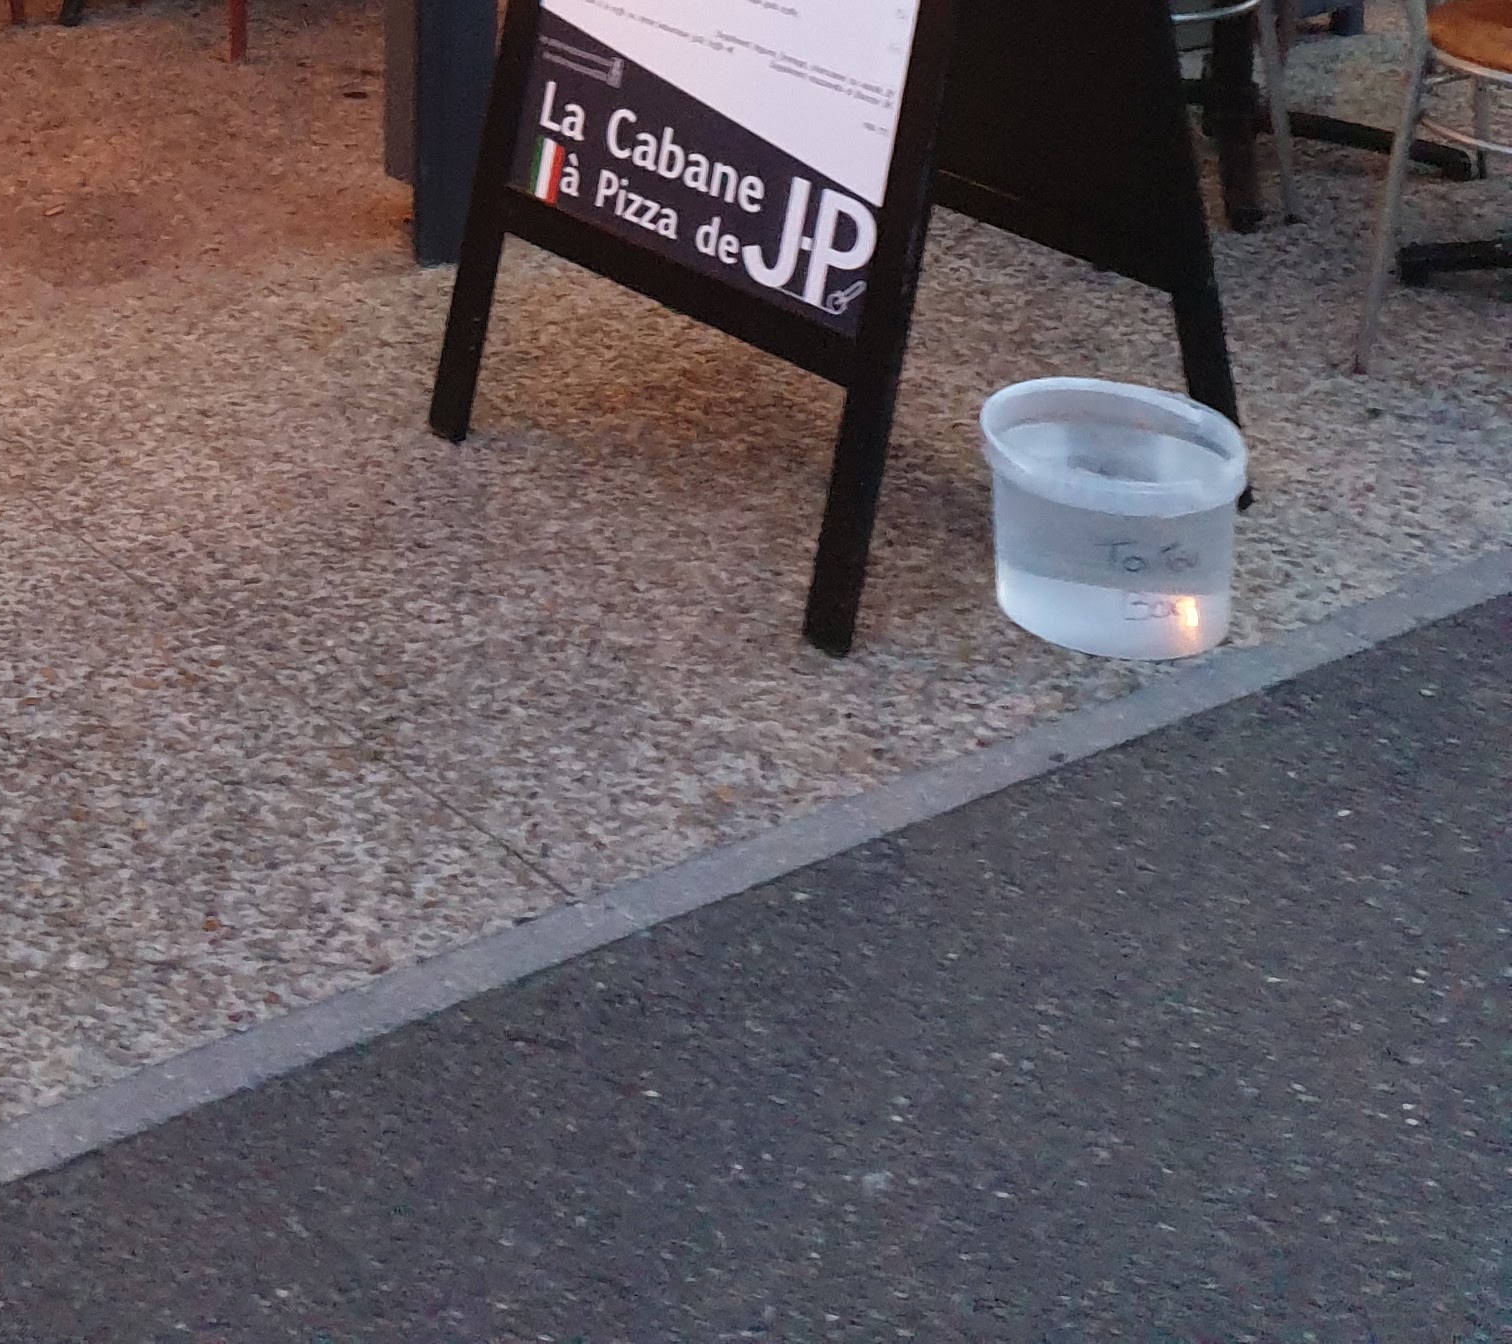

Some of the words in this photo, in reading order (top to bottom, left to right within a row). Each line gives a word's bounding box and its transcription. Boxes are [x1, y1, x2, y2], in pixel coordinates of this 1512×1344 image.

[539, 81, 585, 142] La
[606, 108, 765, 213] Cabane
[559, 154, 581, 198] à
[594, 169, 678, 240] Pizza
[695, 216, 738, 265] de
